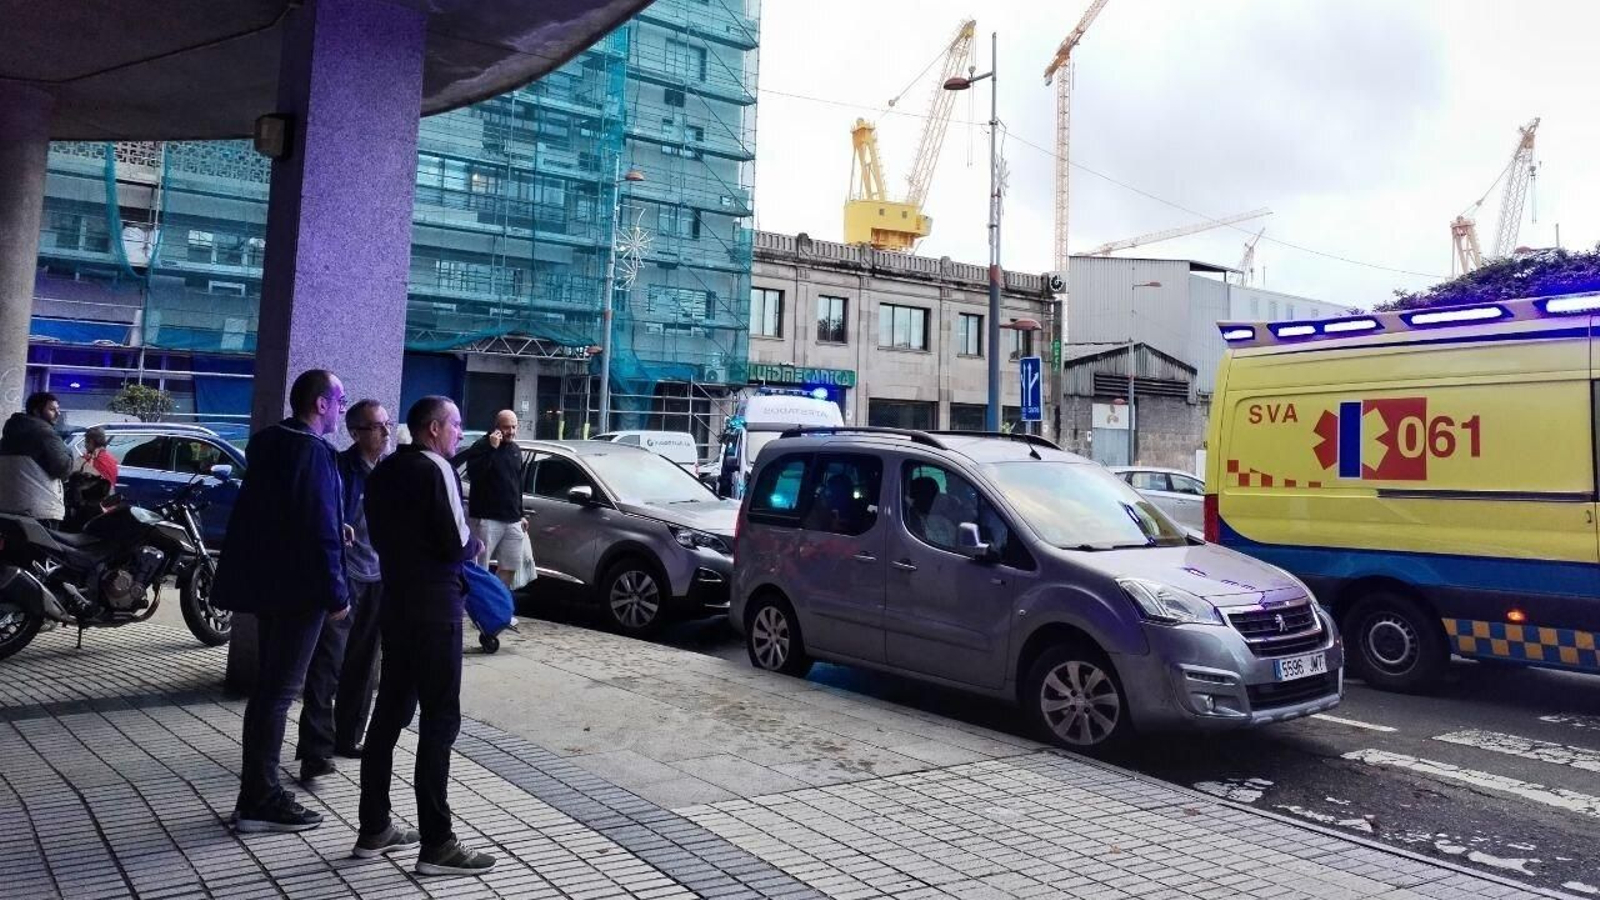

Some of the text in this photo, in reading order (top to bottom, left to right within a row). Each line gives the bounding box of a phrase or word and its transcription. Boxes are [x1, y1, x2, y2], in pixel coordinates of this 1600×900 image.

[745, 365, 849, 385] LUIDMECANICA
[1248, 403, 1298, 425] SVA
[1397, 414, 1481, 459] 061
[1281, 654, 1323, 678] 5596 JMT
